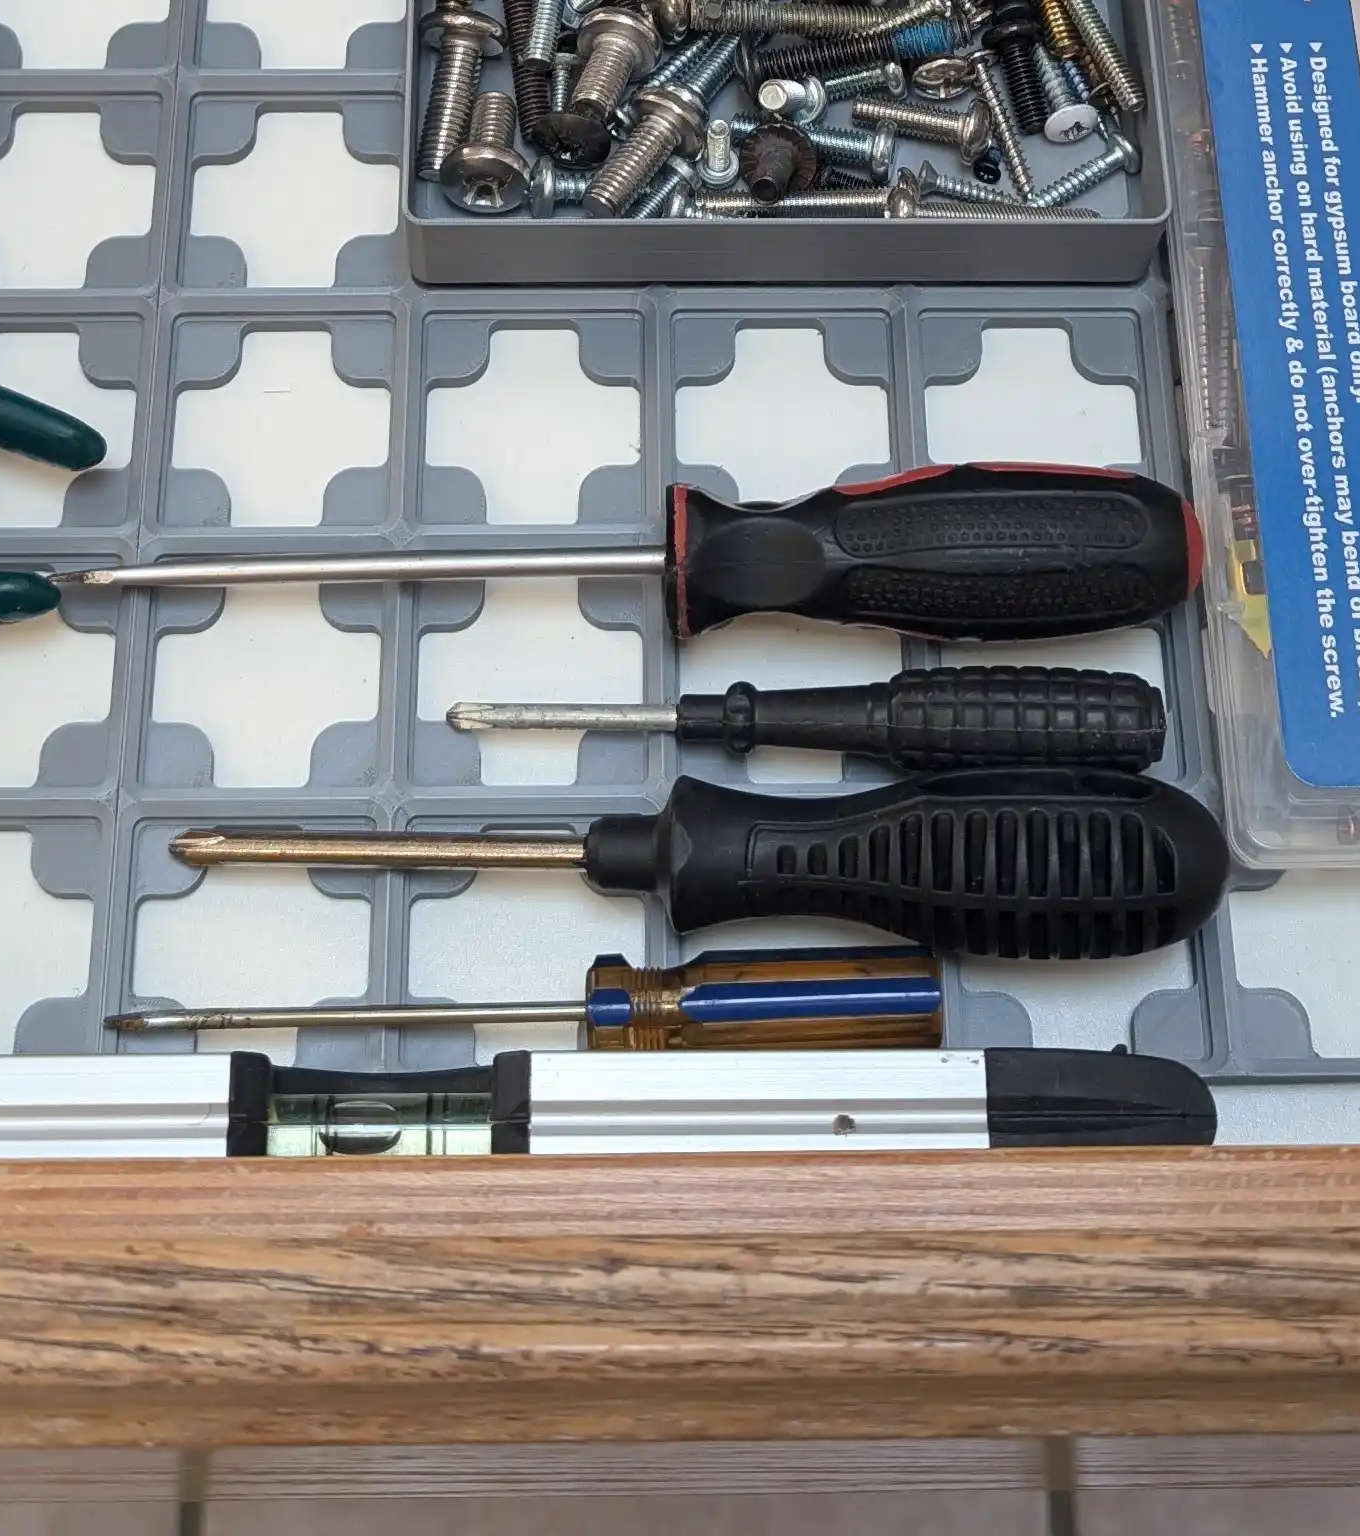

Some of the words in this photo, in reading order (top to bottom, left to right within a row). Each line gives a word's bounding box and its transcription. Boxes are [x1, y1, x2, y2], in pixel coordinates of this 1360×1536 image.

[1249, 57, 1273, 145] Hammer
[1279, 56, 1303, 113] Avoid
[1308, 57, 1339, 152] Designed
[1287, 118, 1308, 175] using
[1322, 156, 1340, 186] for
[1261, 149, 1284, 224] anchor
[1295, 180, 1311, 207] on
[1299, 212, 1323, 261] hard
[1322, 190, 1351, 275] gypsum
[1271, 228, 1299, 331] correctly
[1307, 267, 1336, 360] material
[1284, 337, 1303, 354] &
[1287, 360, 1307, 388] do
[1291, 394, 1313, 432] not
[1314, 366, 1345, 468] (anchors
[1297, 437, 1328, 581] over-tighten
[1332, 474, 1353, 525] may
[1315, 588, 1335, 628] the
[1320, 635, 1344, 717] screw.
